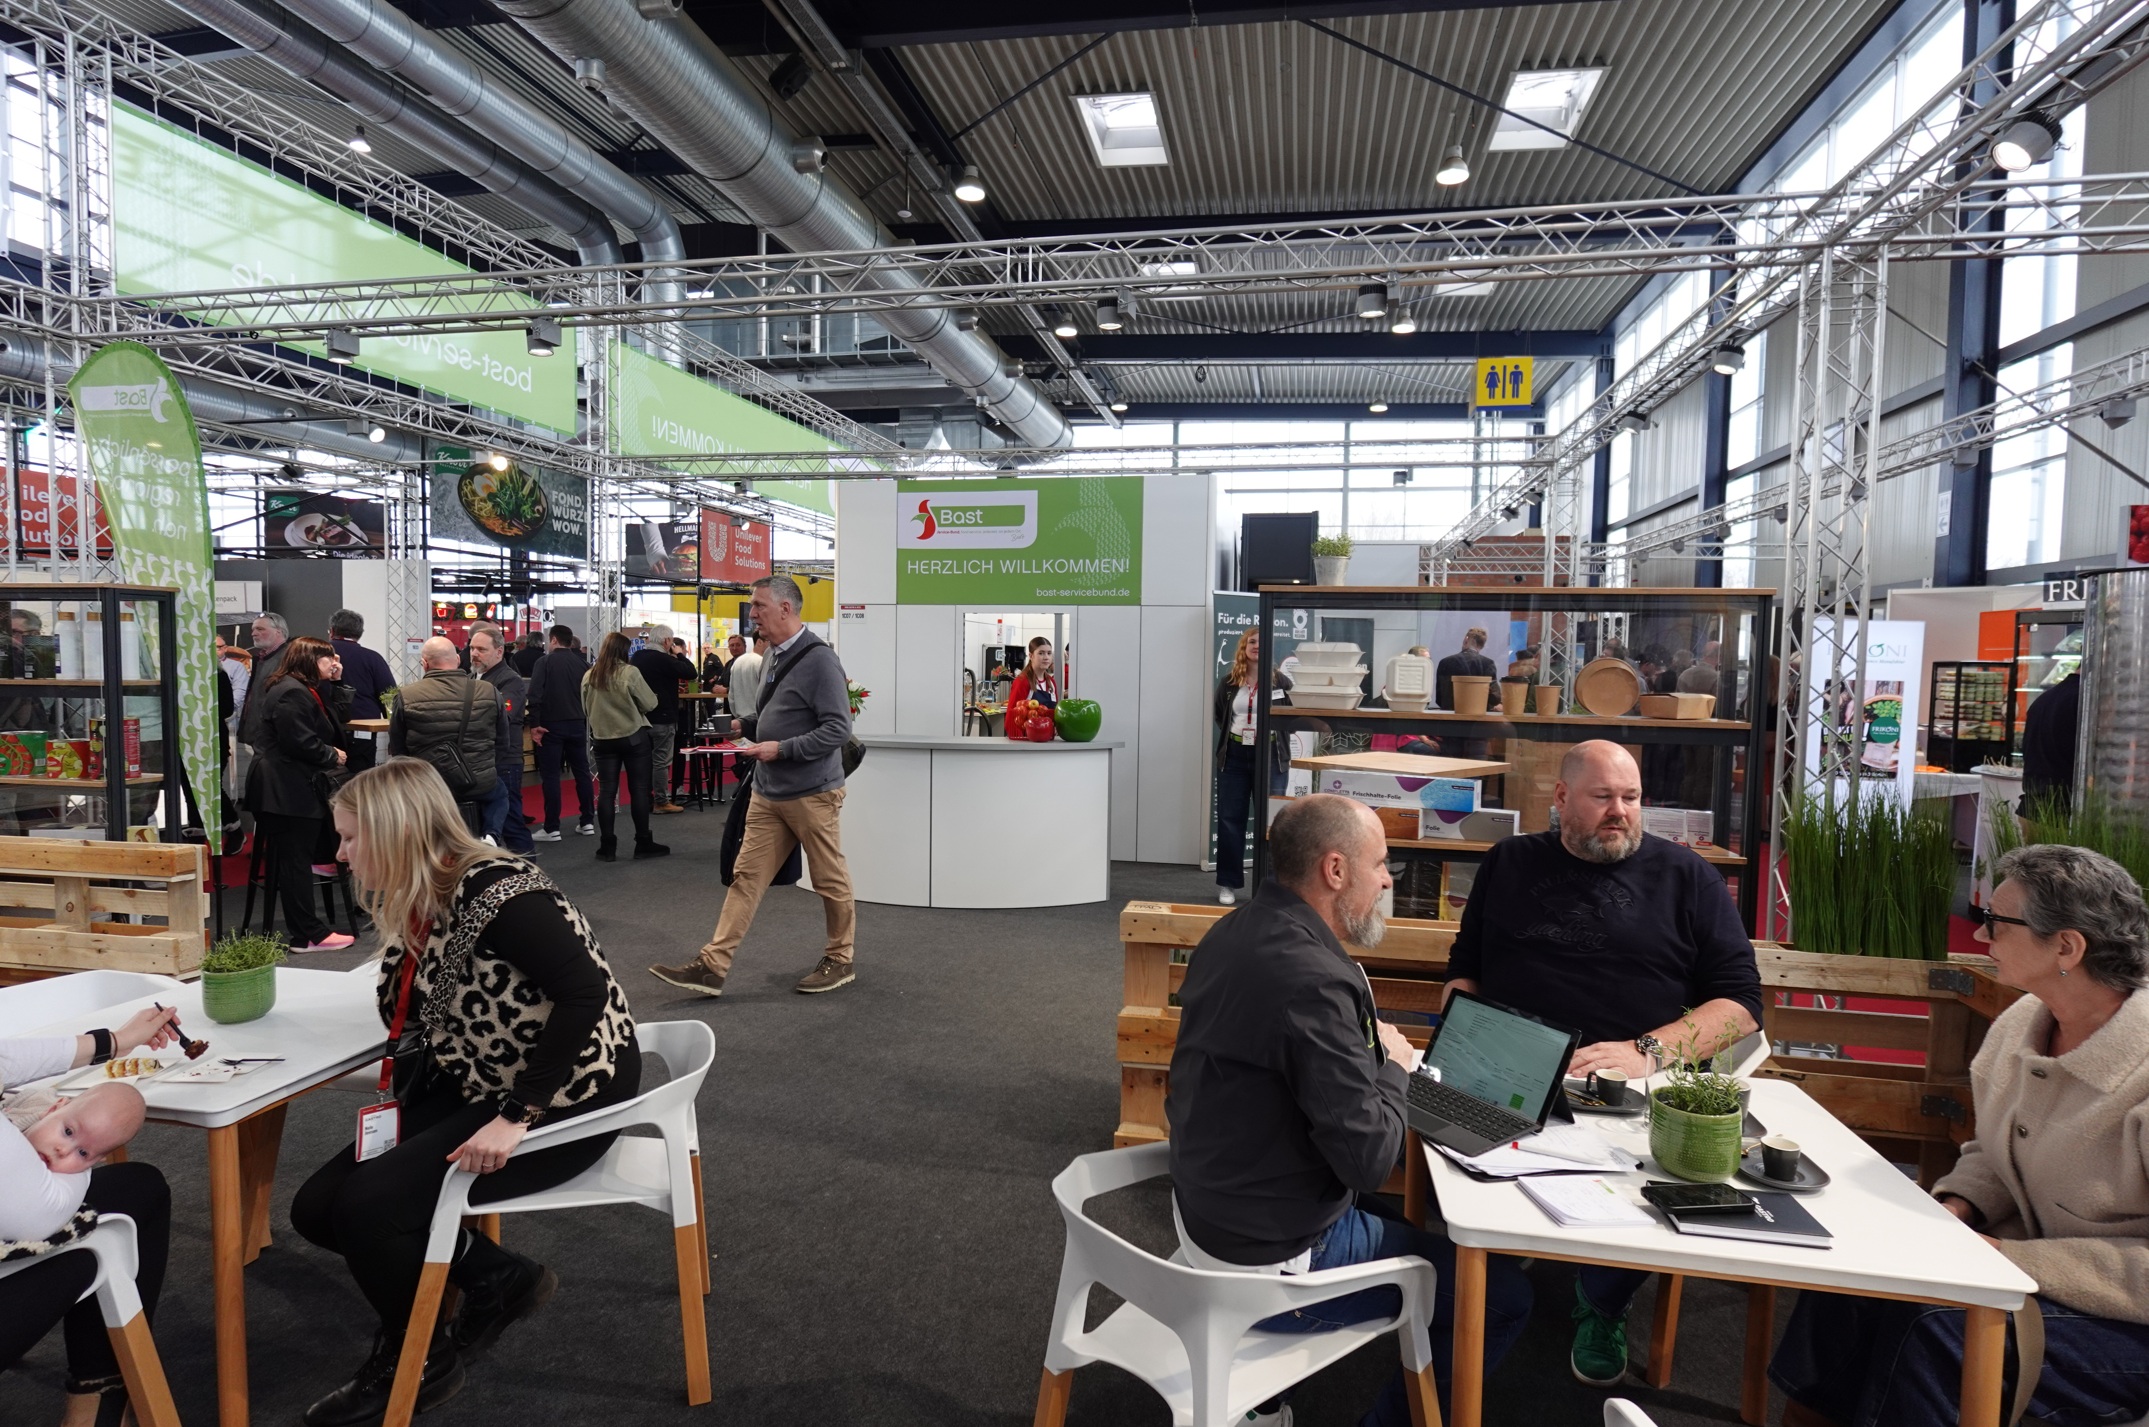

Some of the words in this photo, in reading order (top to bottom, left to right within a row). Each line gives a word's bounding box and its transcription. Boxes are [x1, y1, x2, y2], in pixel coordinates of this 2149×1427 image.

[552, 491, 585, 510] FOND,
[940, 509, 983, 524] Bast
[552, 519, 583, 536] WOW.
[735, 527, 763, 543] Unilever
[735, 544, 752, 555] Food
[735, 555, 766, 570] Solutions
[907, 560, 994, 574] HERZLICH
[999, 559, 1131, 574] WILLKOMMEN!
[1036, 588, 1131, 597] bast-servicebund.de
[1217, 612, 1234, 624] Für
[1237, 614, 1251, 625] die
[1352, 791, 1402, 800] Frischhalte-Folie
